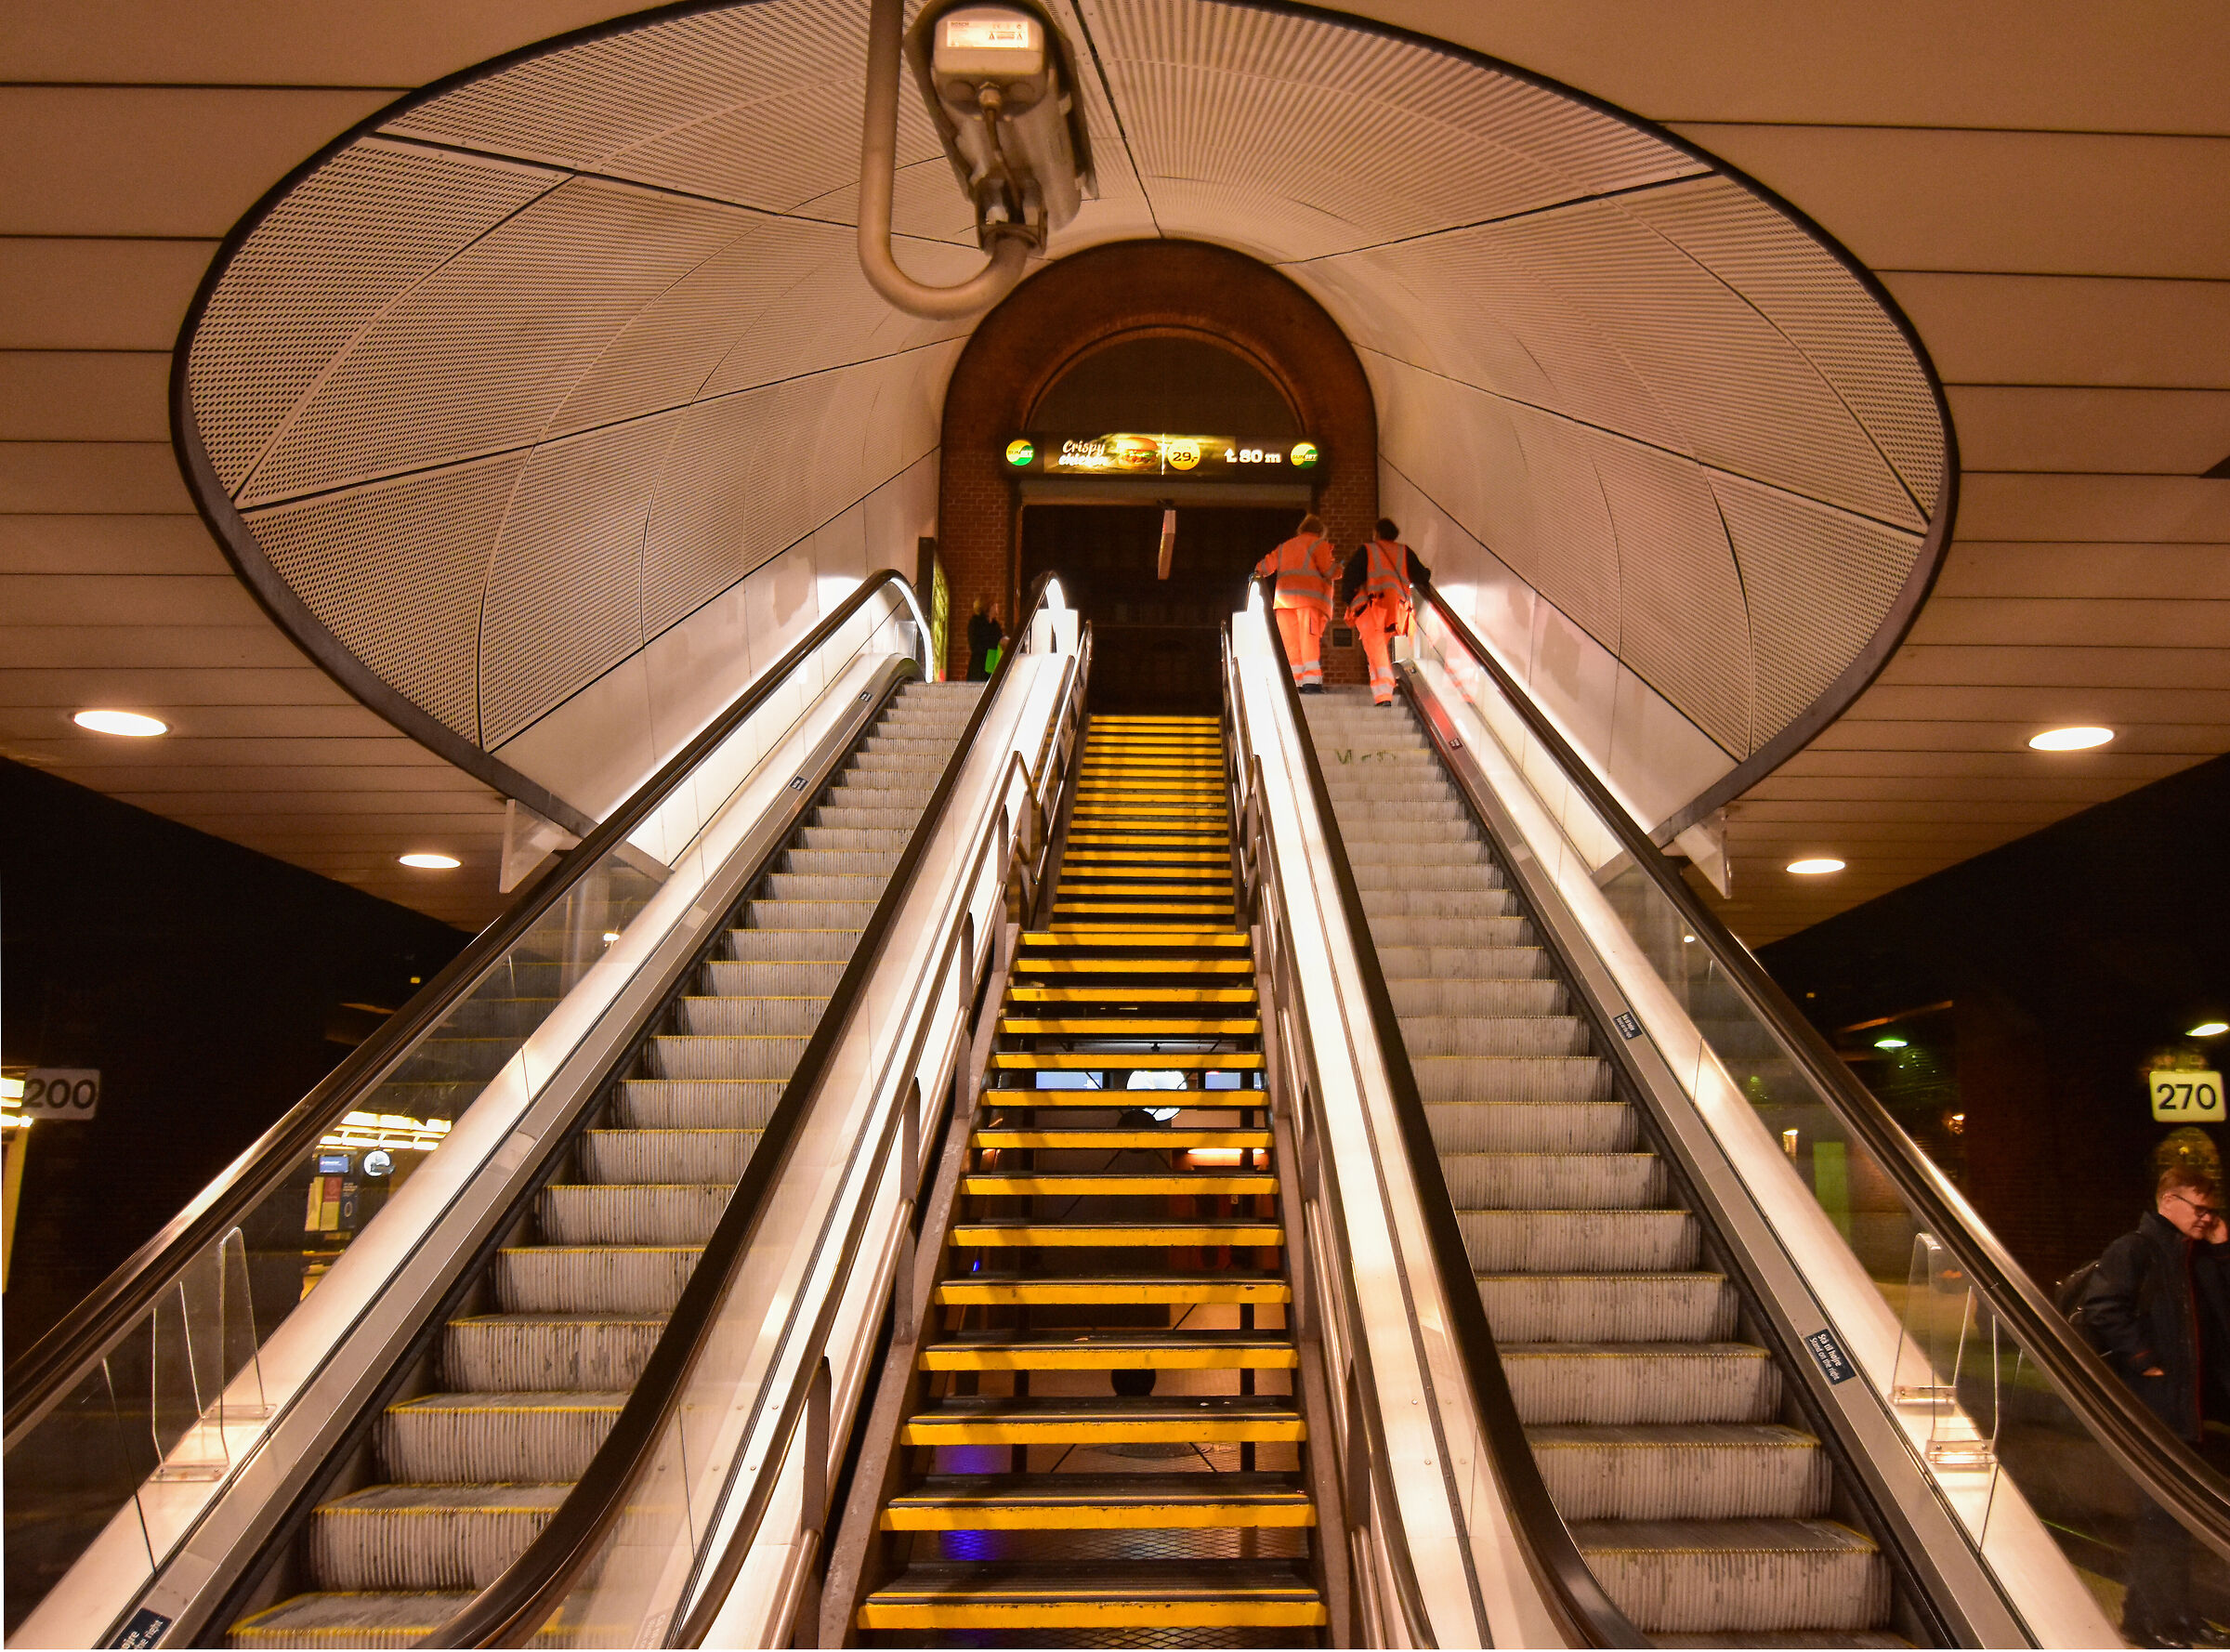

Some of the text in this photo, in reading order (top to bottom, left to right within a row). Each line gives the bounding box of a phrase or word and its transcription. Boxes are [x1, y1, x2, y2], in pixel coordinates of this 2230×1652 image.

[1062, 439, 1106, 456] Crispy
[1239, 449, 1281, 464] 80 m
[24, 1078, 97, 1109] 200
[2157, 1082, 2216, 1110] 270
[1809, 1337, 1823, 1353] Stand
